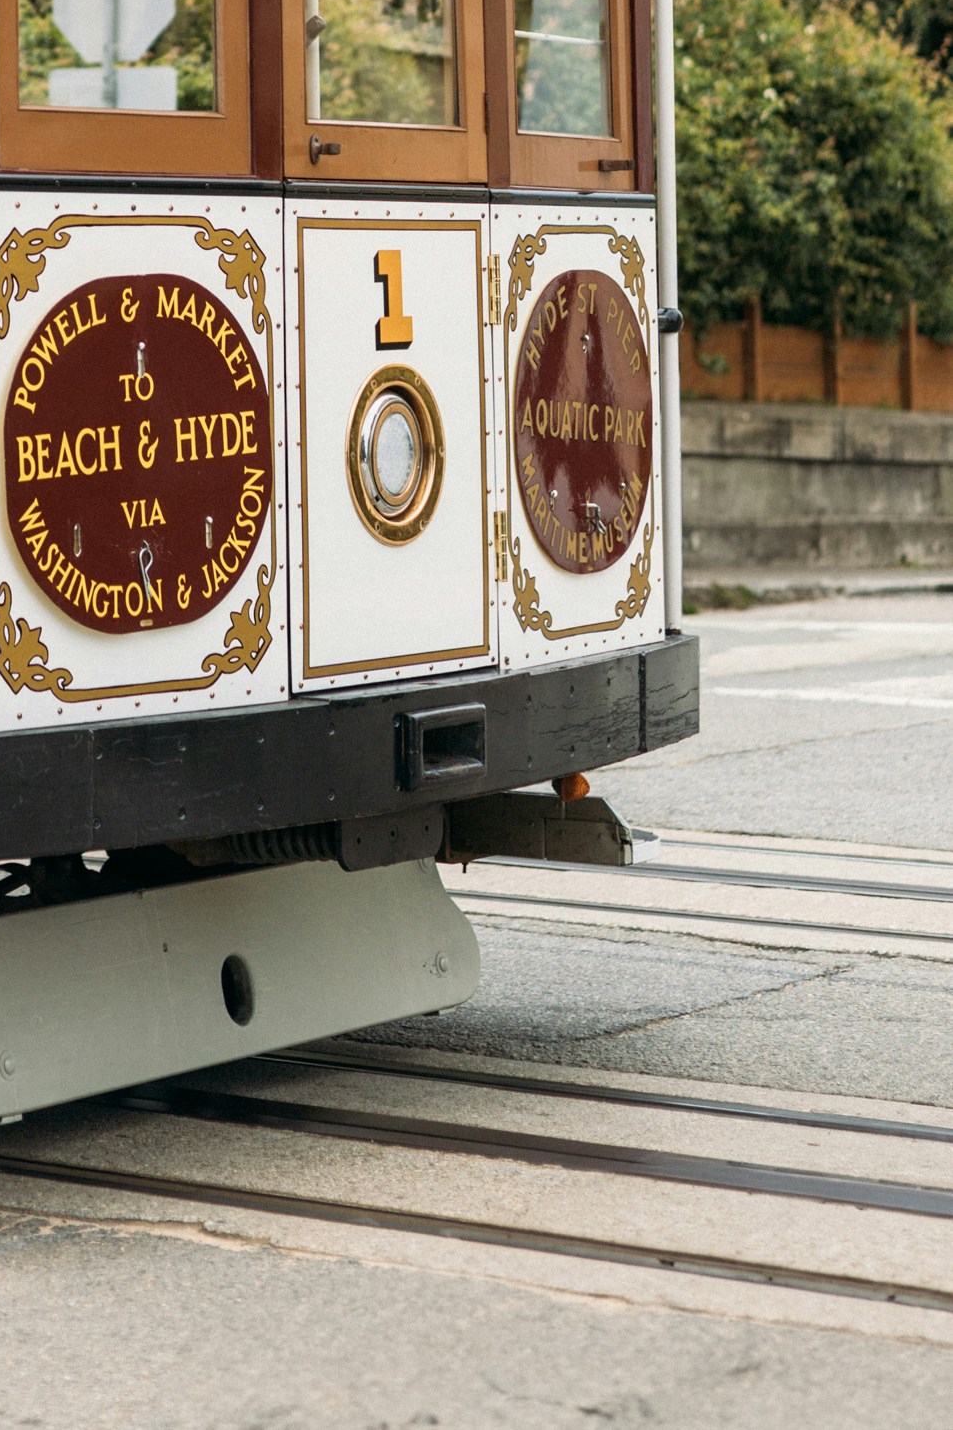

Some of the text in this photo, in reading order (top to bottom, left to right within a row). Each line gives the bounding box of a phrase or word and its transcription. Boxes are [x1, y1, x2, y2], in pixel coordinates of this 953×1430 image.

[377, 249, 414, 344] 1
[525, 284, 569, 371] HYDE
[606, 296, 642, 376] PIER
[13, 285, 257, 414] POWELL & MARKET
[119, 373, 155, 402] TO
[15, 410, 258, 483] BEACH & HYDE
[521, 393, 647, 449] AQUATIC PARK
[18, 465, 266, 619] WASHINGTON & JACKSON
[120, 497, 167, 530] VIA
[521, 452, 643, 564] MARITIME MUSEUM
